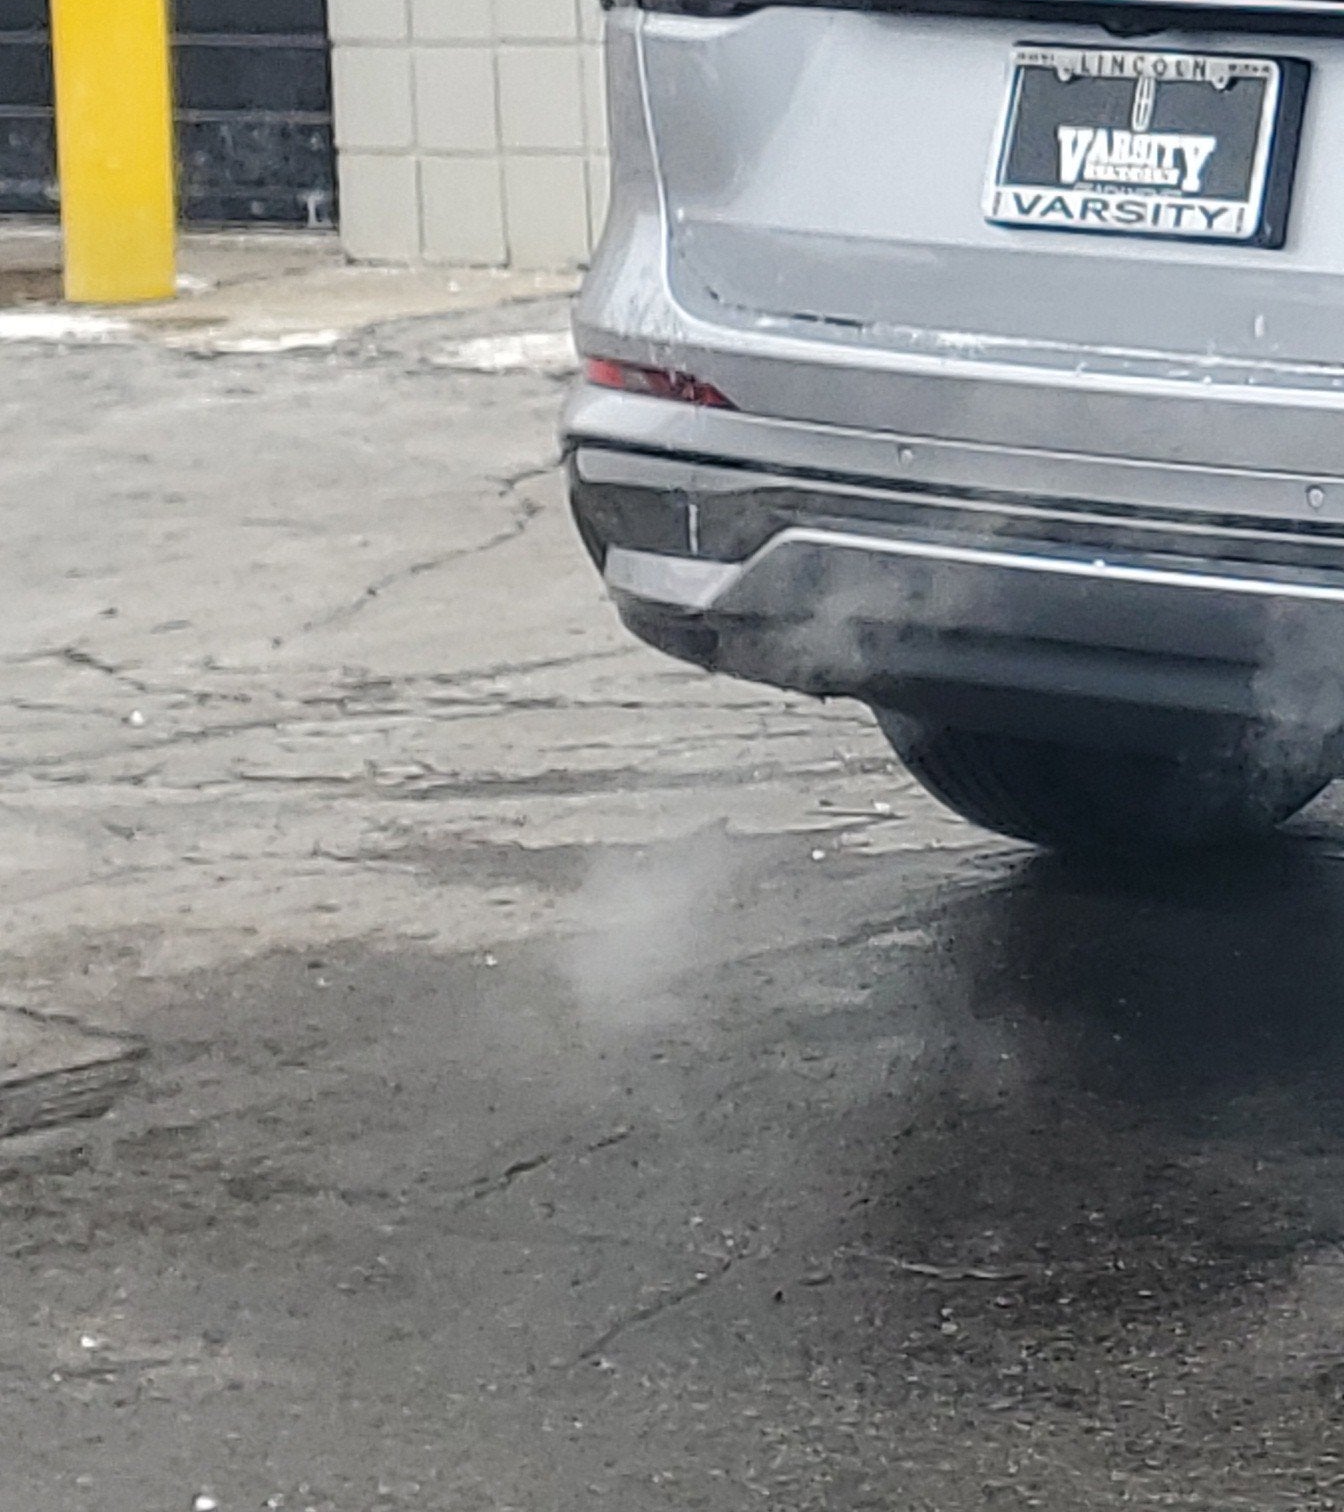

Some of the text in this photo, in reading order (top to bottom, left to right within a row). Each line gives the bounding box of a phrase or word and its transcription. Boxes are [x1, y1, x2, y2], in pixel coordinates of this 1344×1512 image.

[1080, 53, 1208, 81] LINCOLN
[1056, 125, 1217, 192] VARSITY
[1012, 192, 1229, 229] VARSITY
